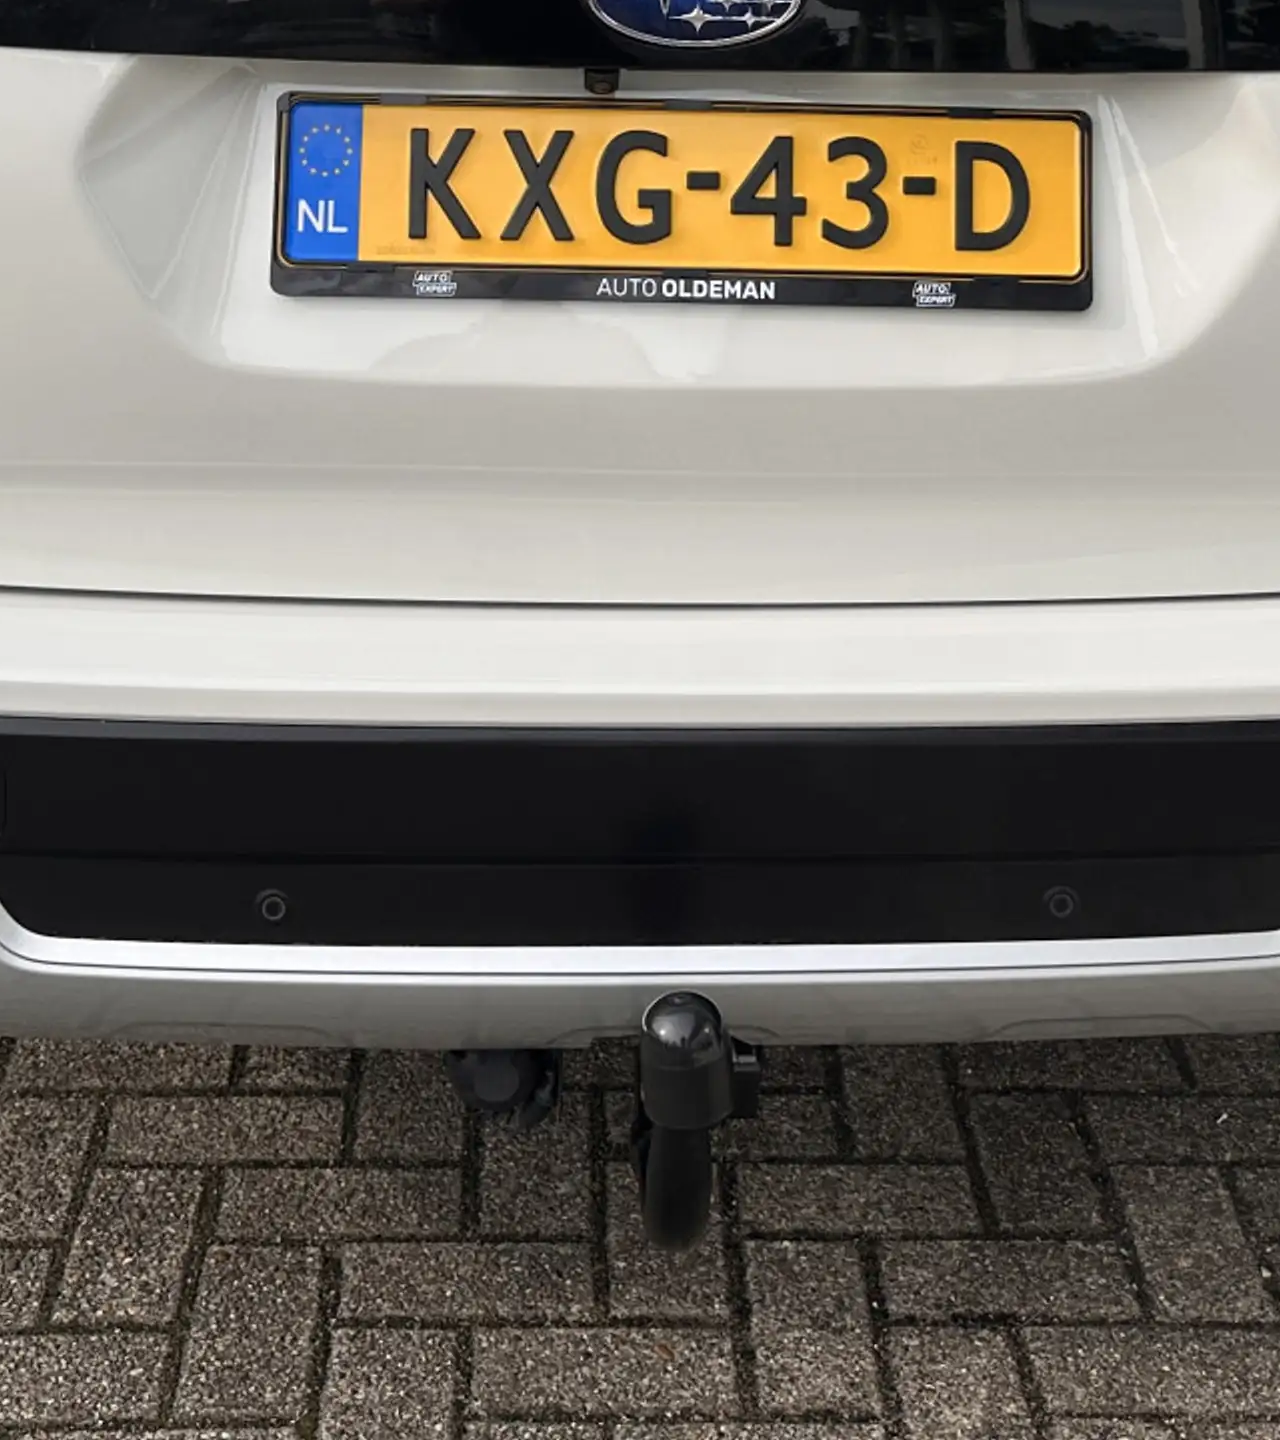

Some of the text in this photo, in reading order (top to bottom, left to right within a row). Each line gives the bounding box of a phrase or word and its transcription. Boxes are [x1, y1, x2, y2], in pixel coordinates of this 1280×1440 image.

[408, 127, 1031, 251] KXG-43-D
[297, 199, 348, 233] NL
[596, 278, 775, 300] AUTO OLDEMAN
